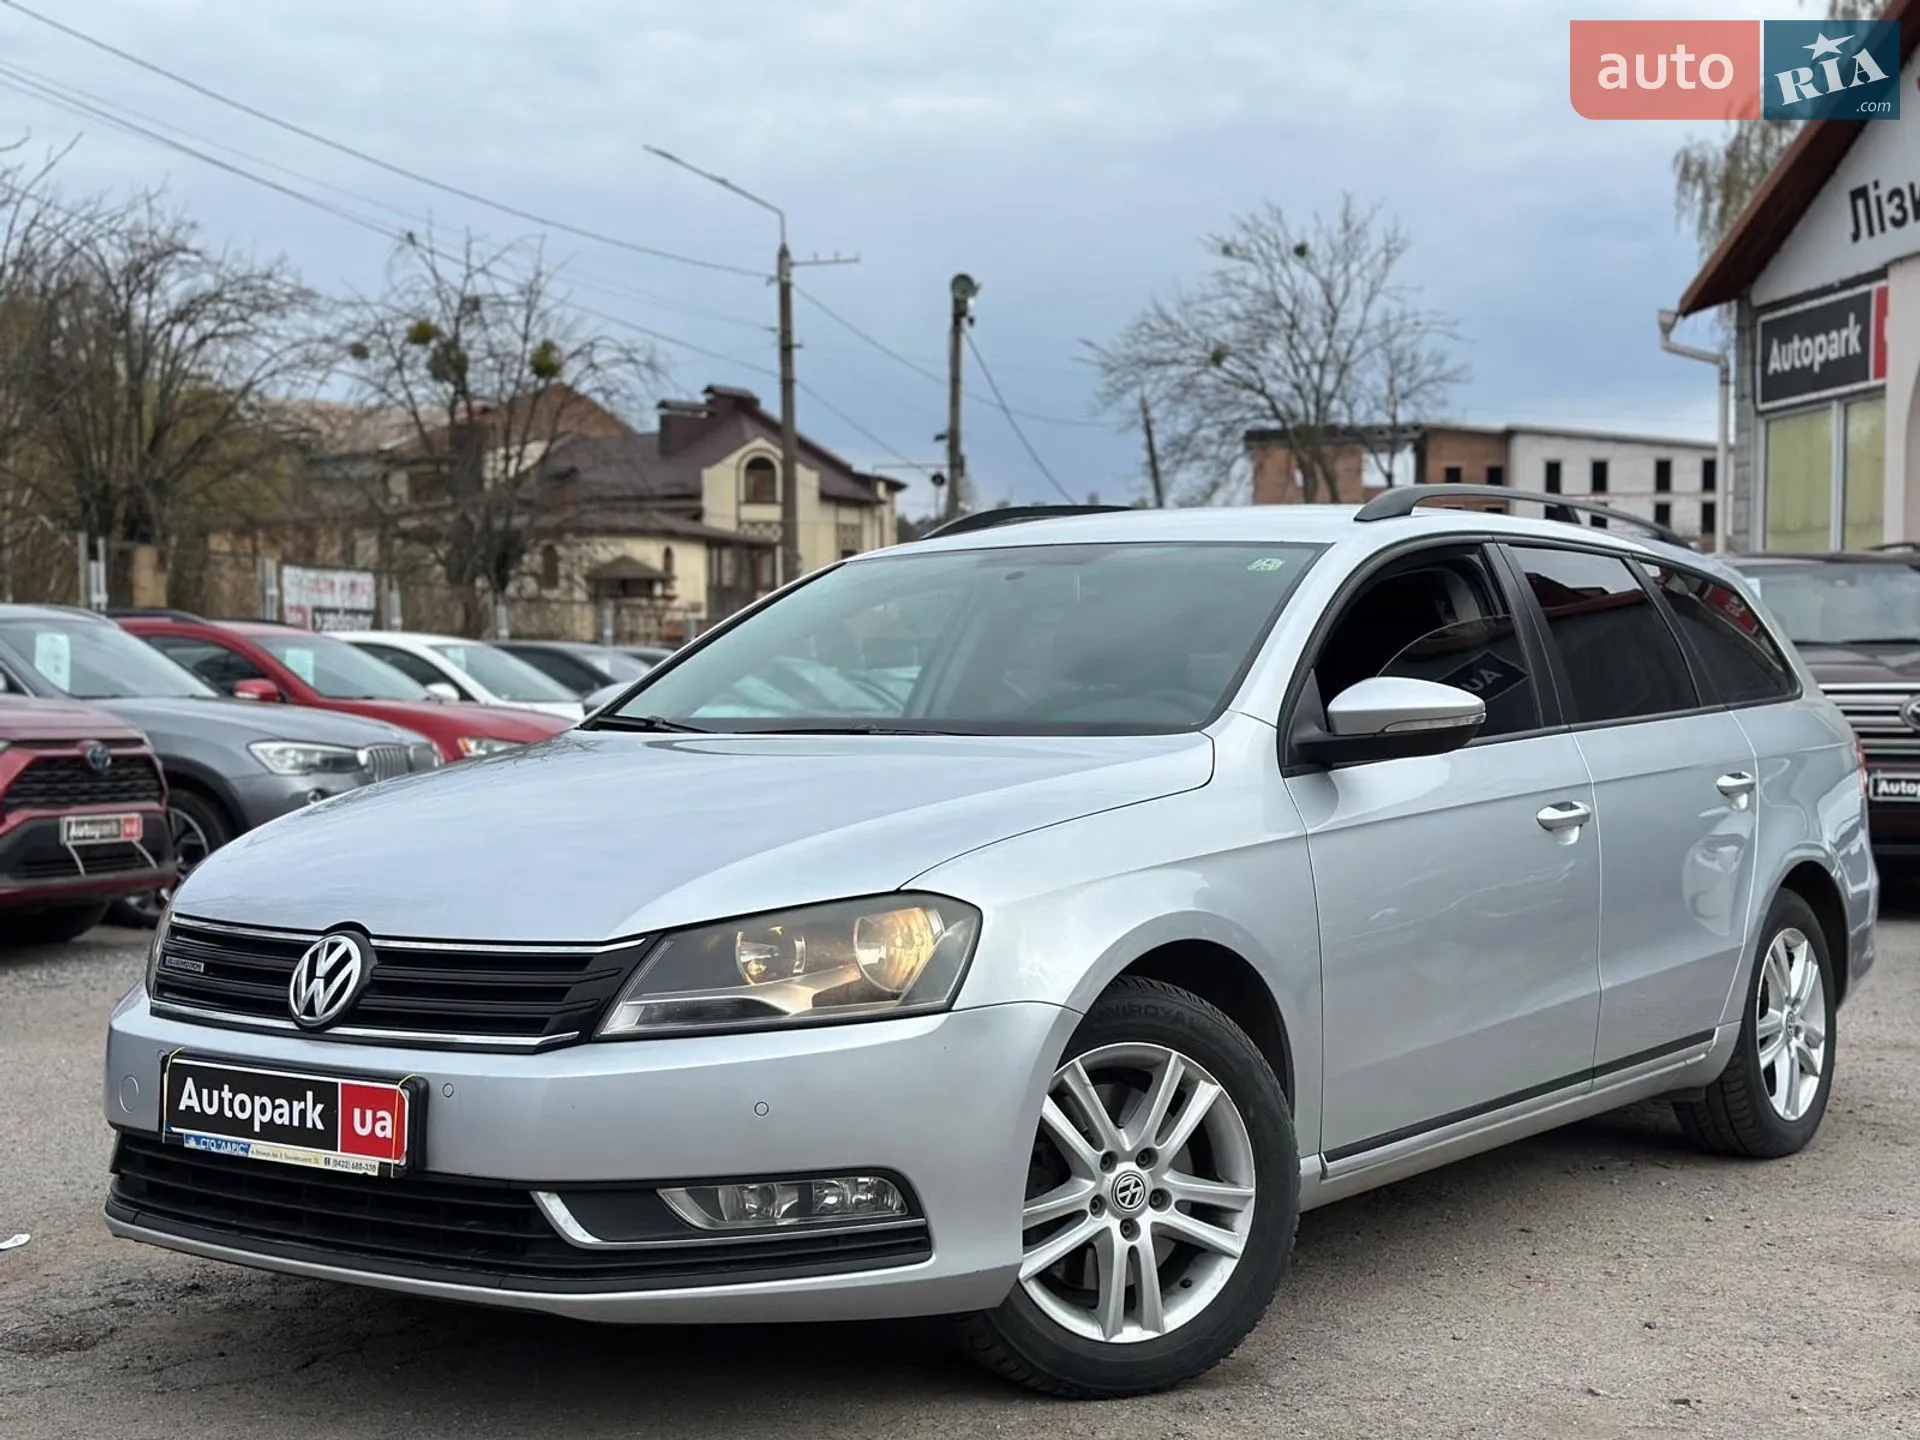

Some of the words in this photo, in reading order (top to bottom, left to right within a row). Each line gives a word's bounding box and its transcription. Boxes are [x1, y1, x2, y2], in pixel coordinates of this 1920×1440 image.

[1767, 312, 1862, 376] Autopark
[178, 1076, 325, 1132] Autopark
[353, 1106, 393, 1139] ua
